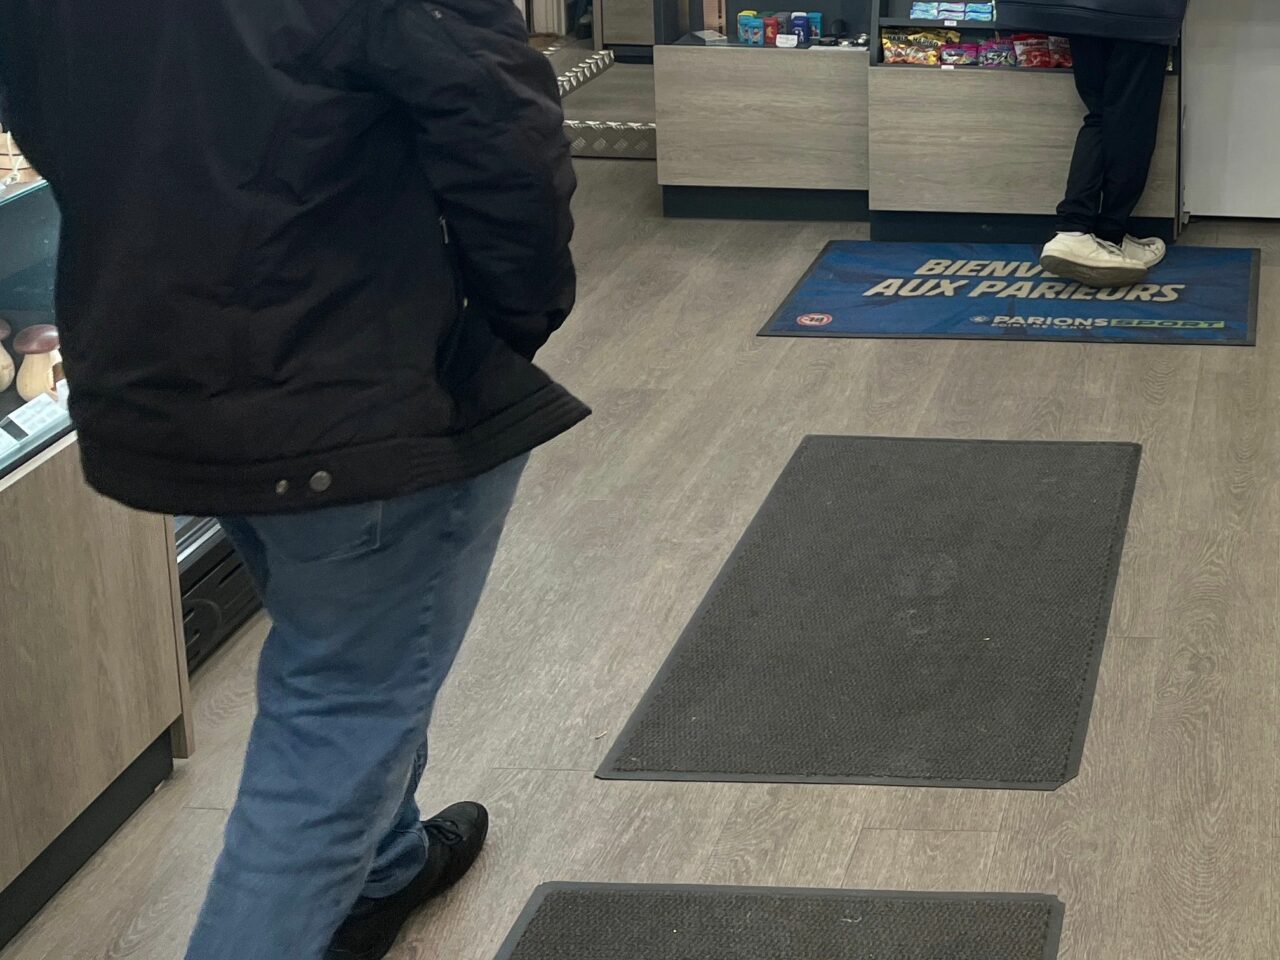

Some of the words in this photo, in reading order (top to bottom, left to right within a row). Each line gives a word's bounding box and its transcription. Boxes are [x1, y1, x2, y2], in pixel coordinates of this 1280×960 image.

[863, 279, 969, 297] AUX
[974, 281, 1186, 303] PARIEURS
[993, 315, 1109, 327] PARIONS
[1111, 319, 1225, 328] SPORT
